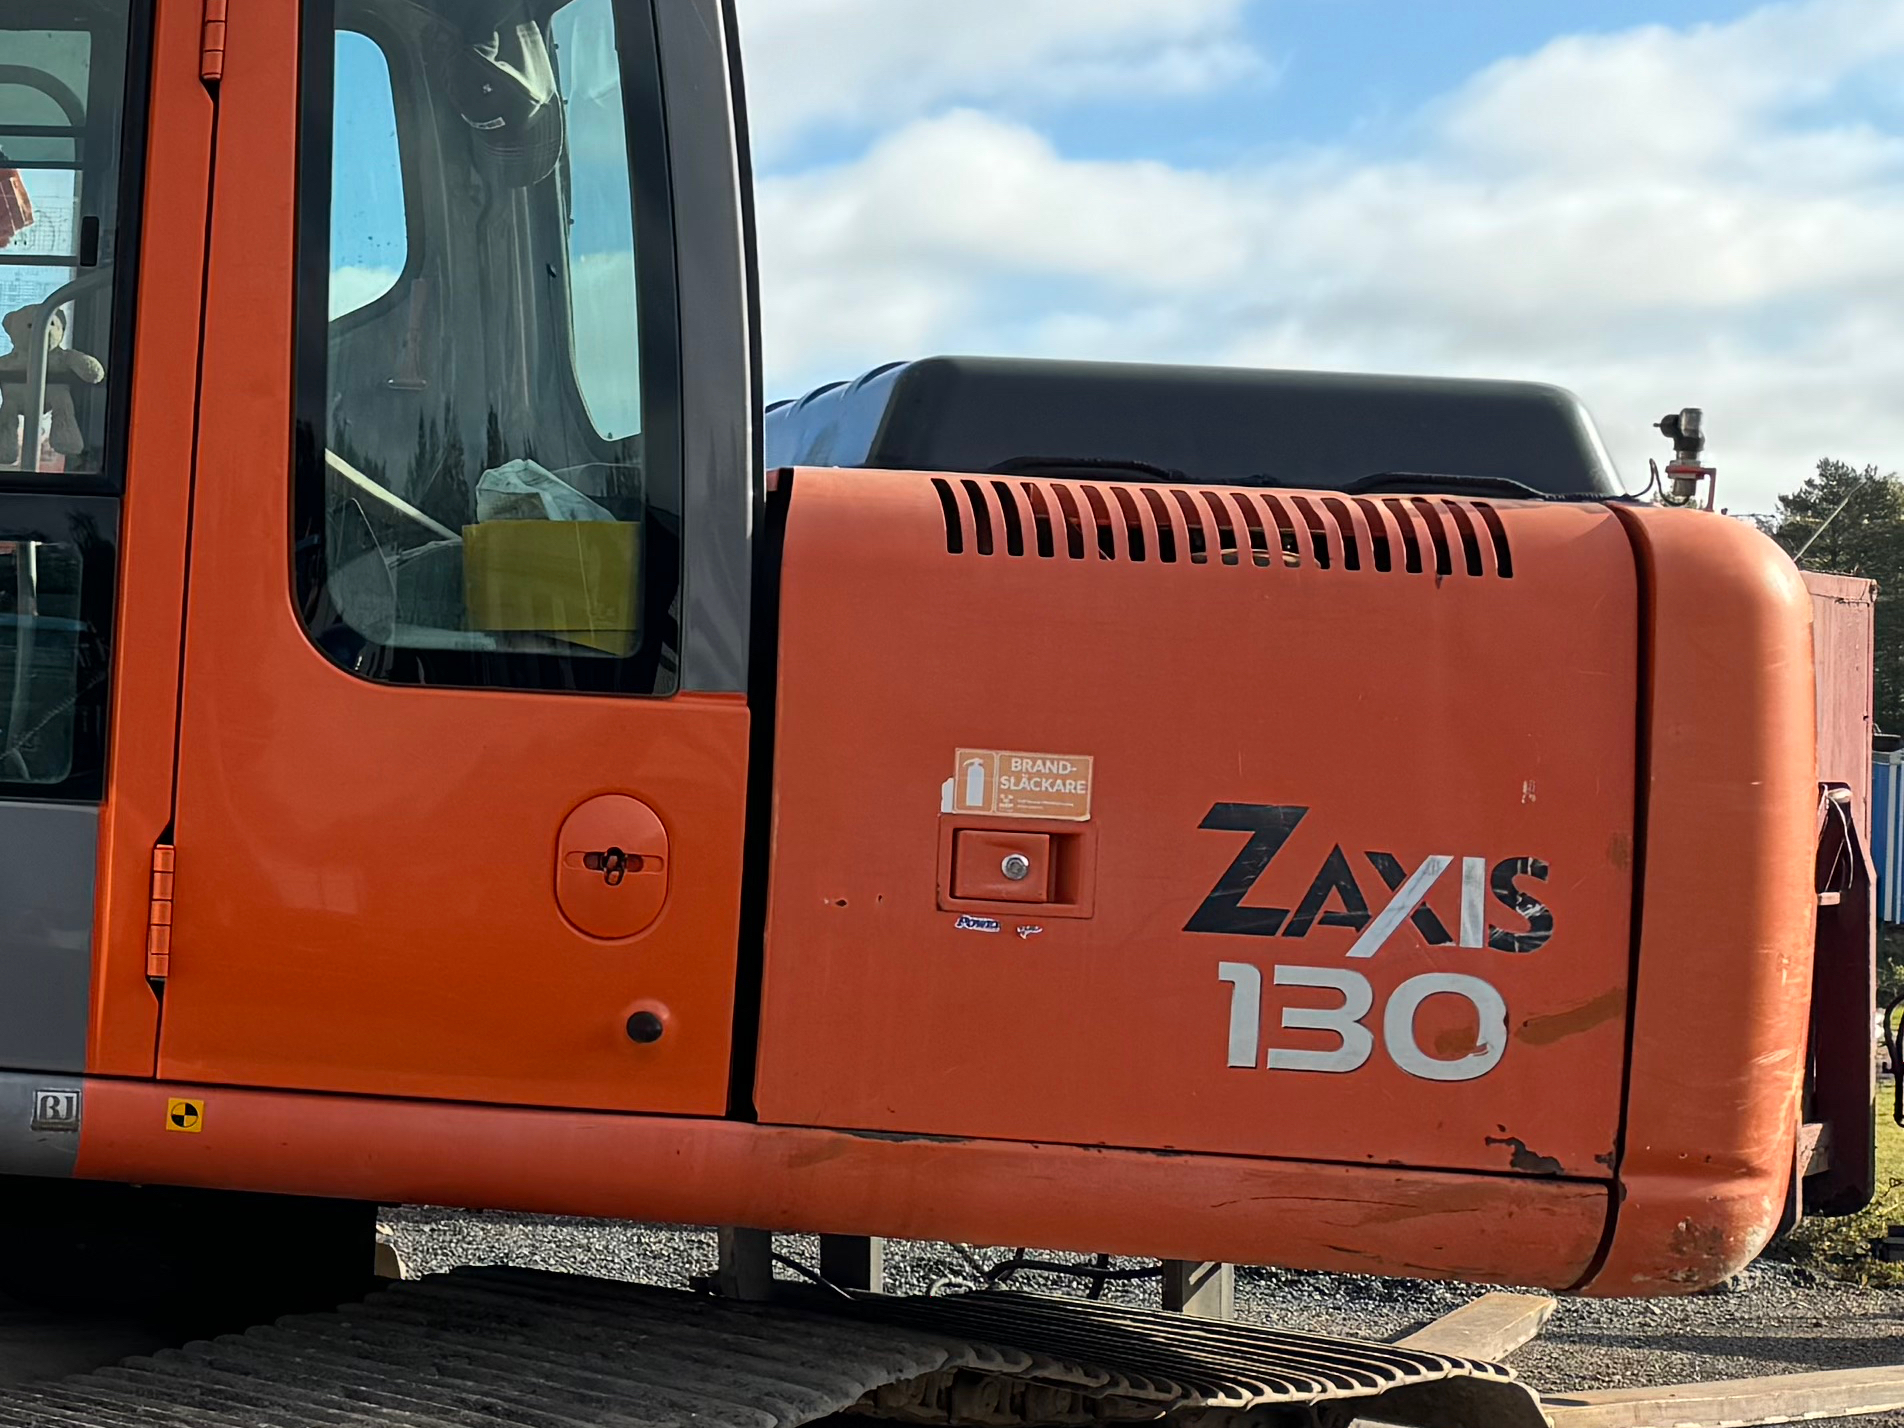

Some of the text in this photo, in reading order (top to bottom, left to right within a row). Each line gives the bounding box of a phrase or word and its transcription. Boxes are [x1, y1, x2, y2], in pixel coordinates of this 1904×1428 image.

[1000, 774, 1087, 794] SLÄCKARE
[1011, 757, 1077, 775] BRAND-
[1182, 802, 1554, 958] ZAXIS
[1218, 961, 1509, 1081] 130
